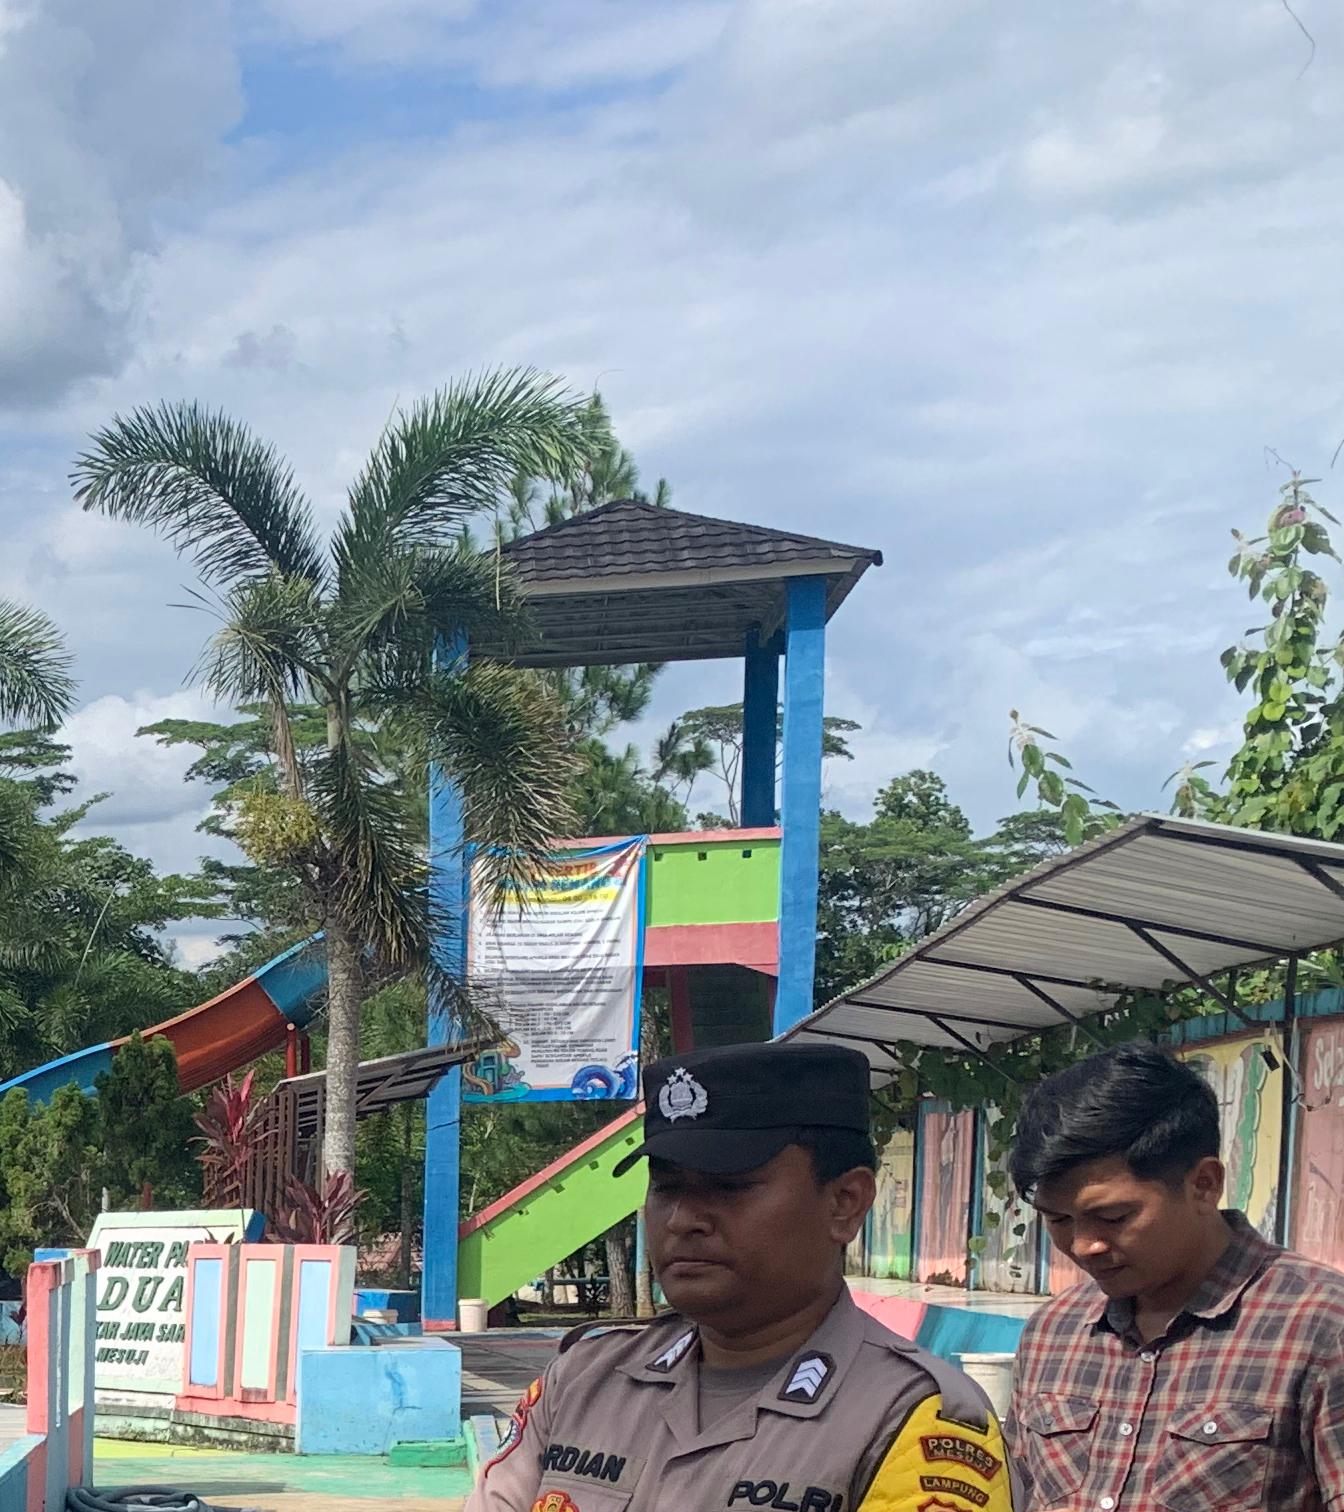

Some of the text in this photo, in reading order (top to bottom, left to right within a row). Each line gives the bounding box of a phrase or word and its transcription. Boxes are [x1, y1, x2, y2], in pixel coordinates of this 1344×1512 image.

[103, 1240, 204, 1269] WATER PA
[96, 1275, 184, 1313] DUA
[119, 1322, 156, 1341] JAYA
[96, 1347, 149, 1366] MESUJI
[541, 1443, 627, 1482] RDIAN
[927, 1438, 994, 1468] POLRES
[923, 1477, 985, 1503] LAMPUNG
